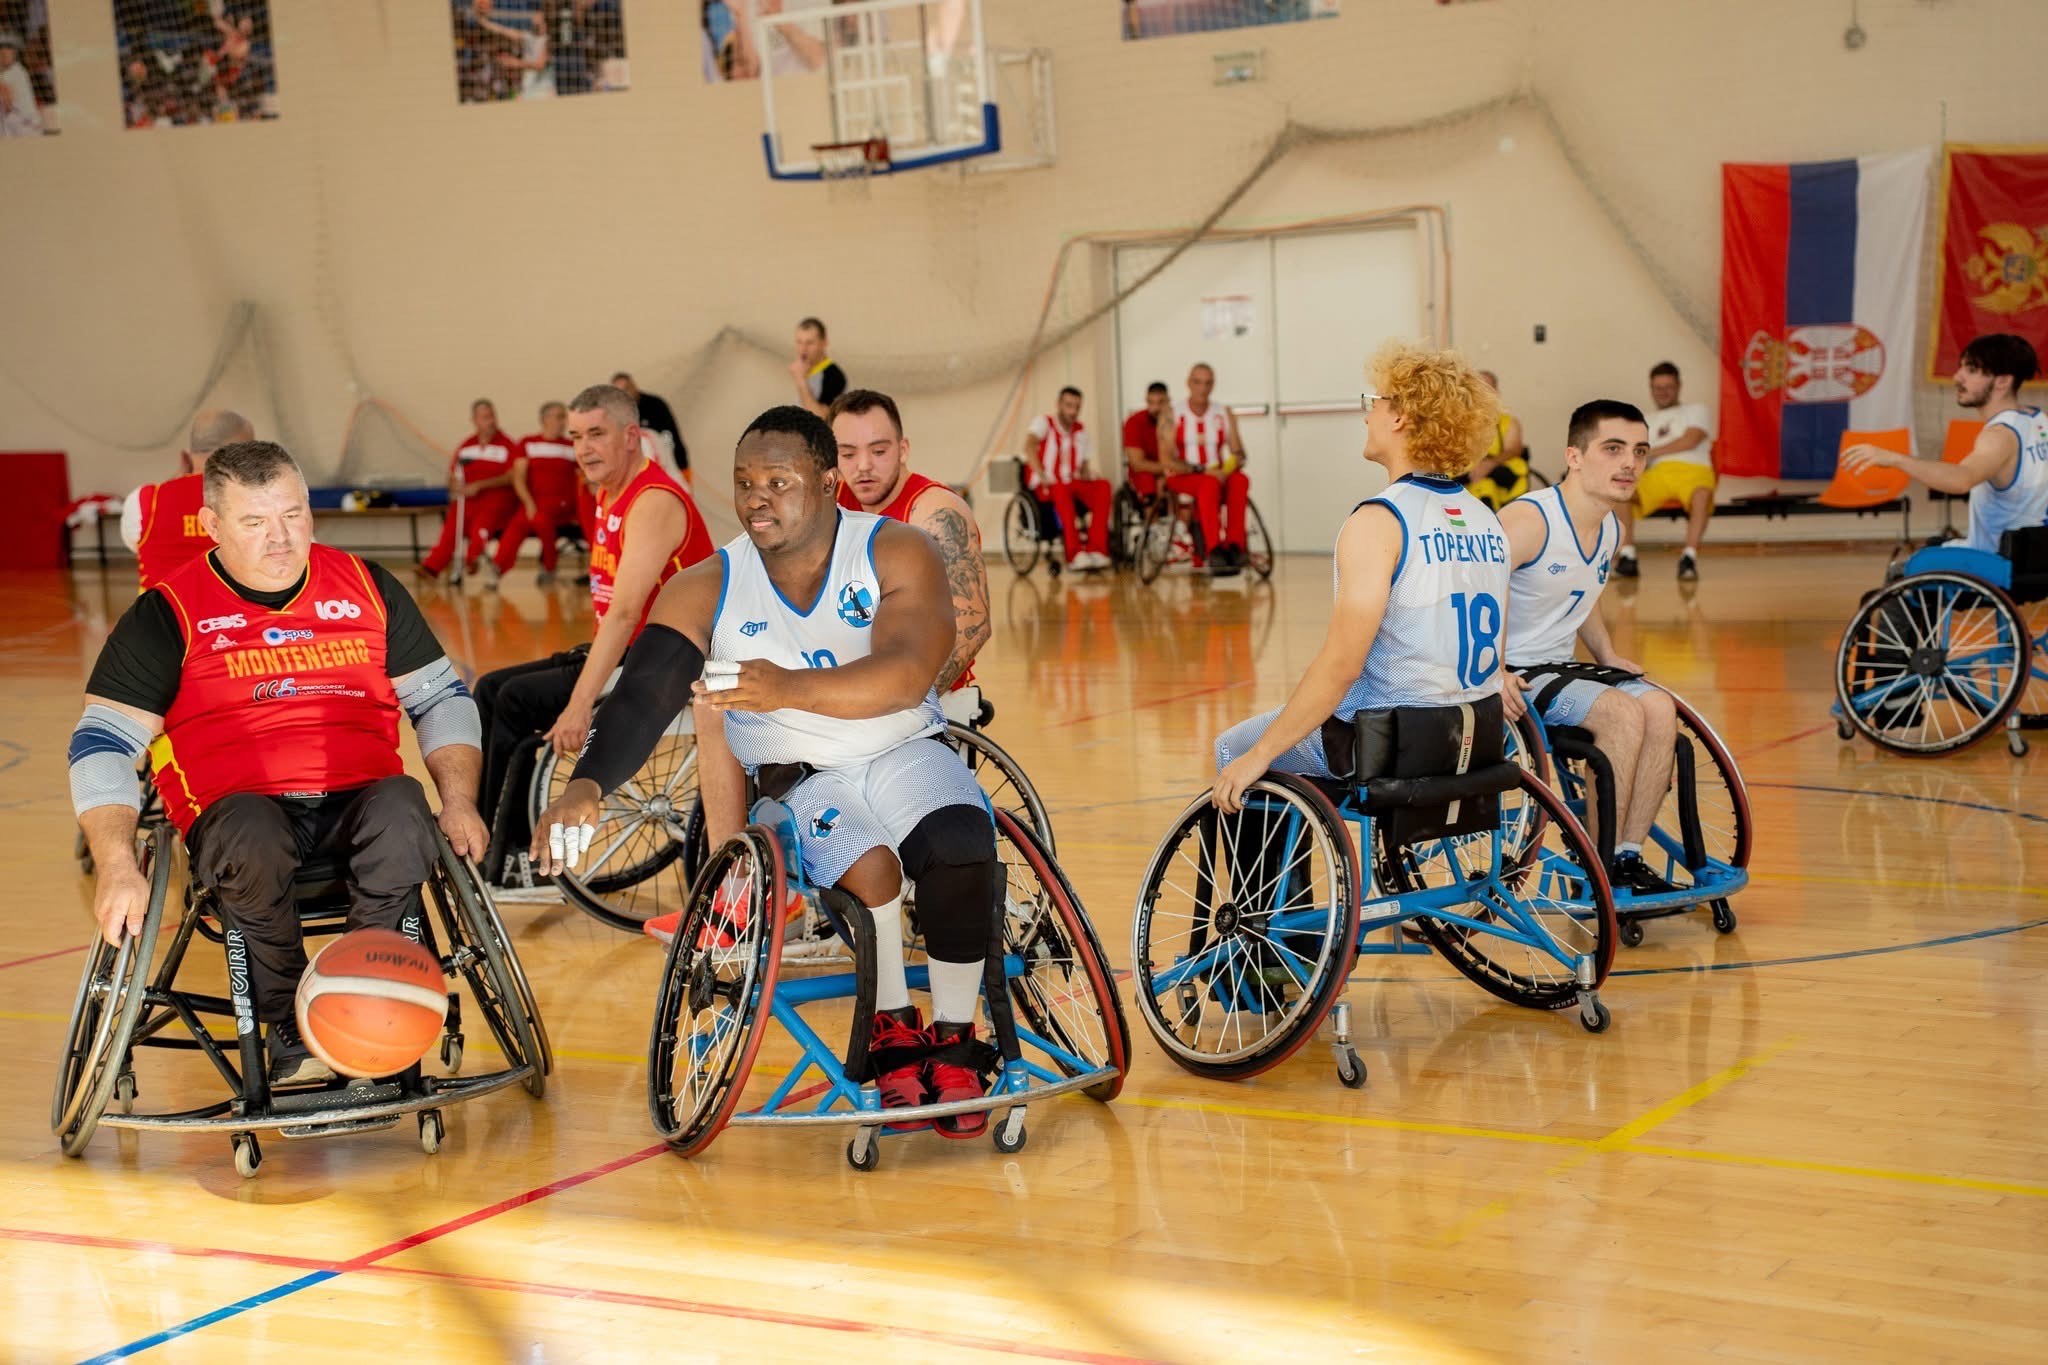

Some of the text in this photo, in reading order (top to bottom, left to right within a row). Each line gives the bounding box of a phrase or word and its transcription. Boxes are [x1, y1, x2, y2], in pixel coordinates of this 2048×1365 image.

[1561, 590, 1586, 619] 7
[225, 639, 370, 679] MONTENEGRO
[1450, 592, 1501, 690] 18
